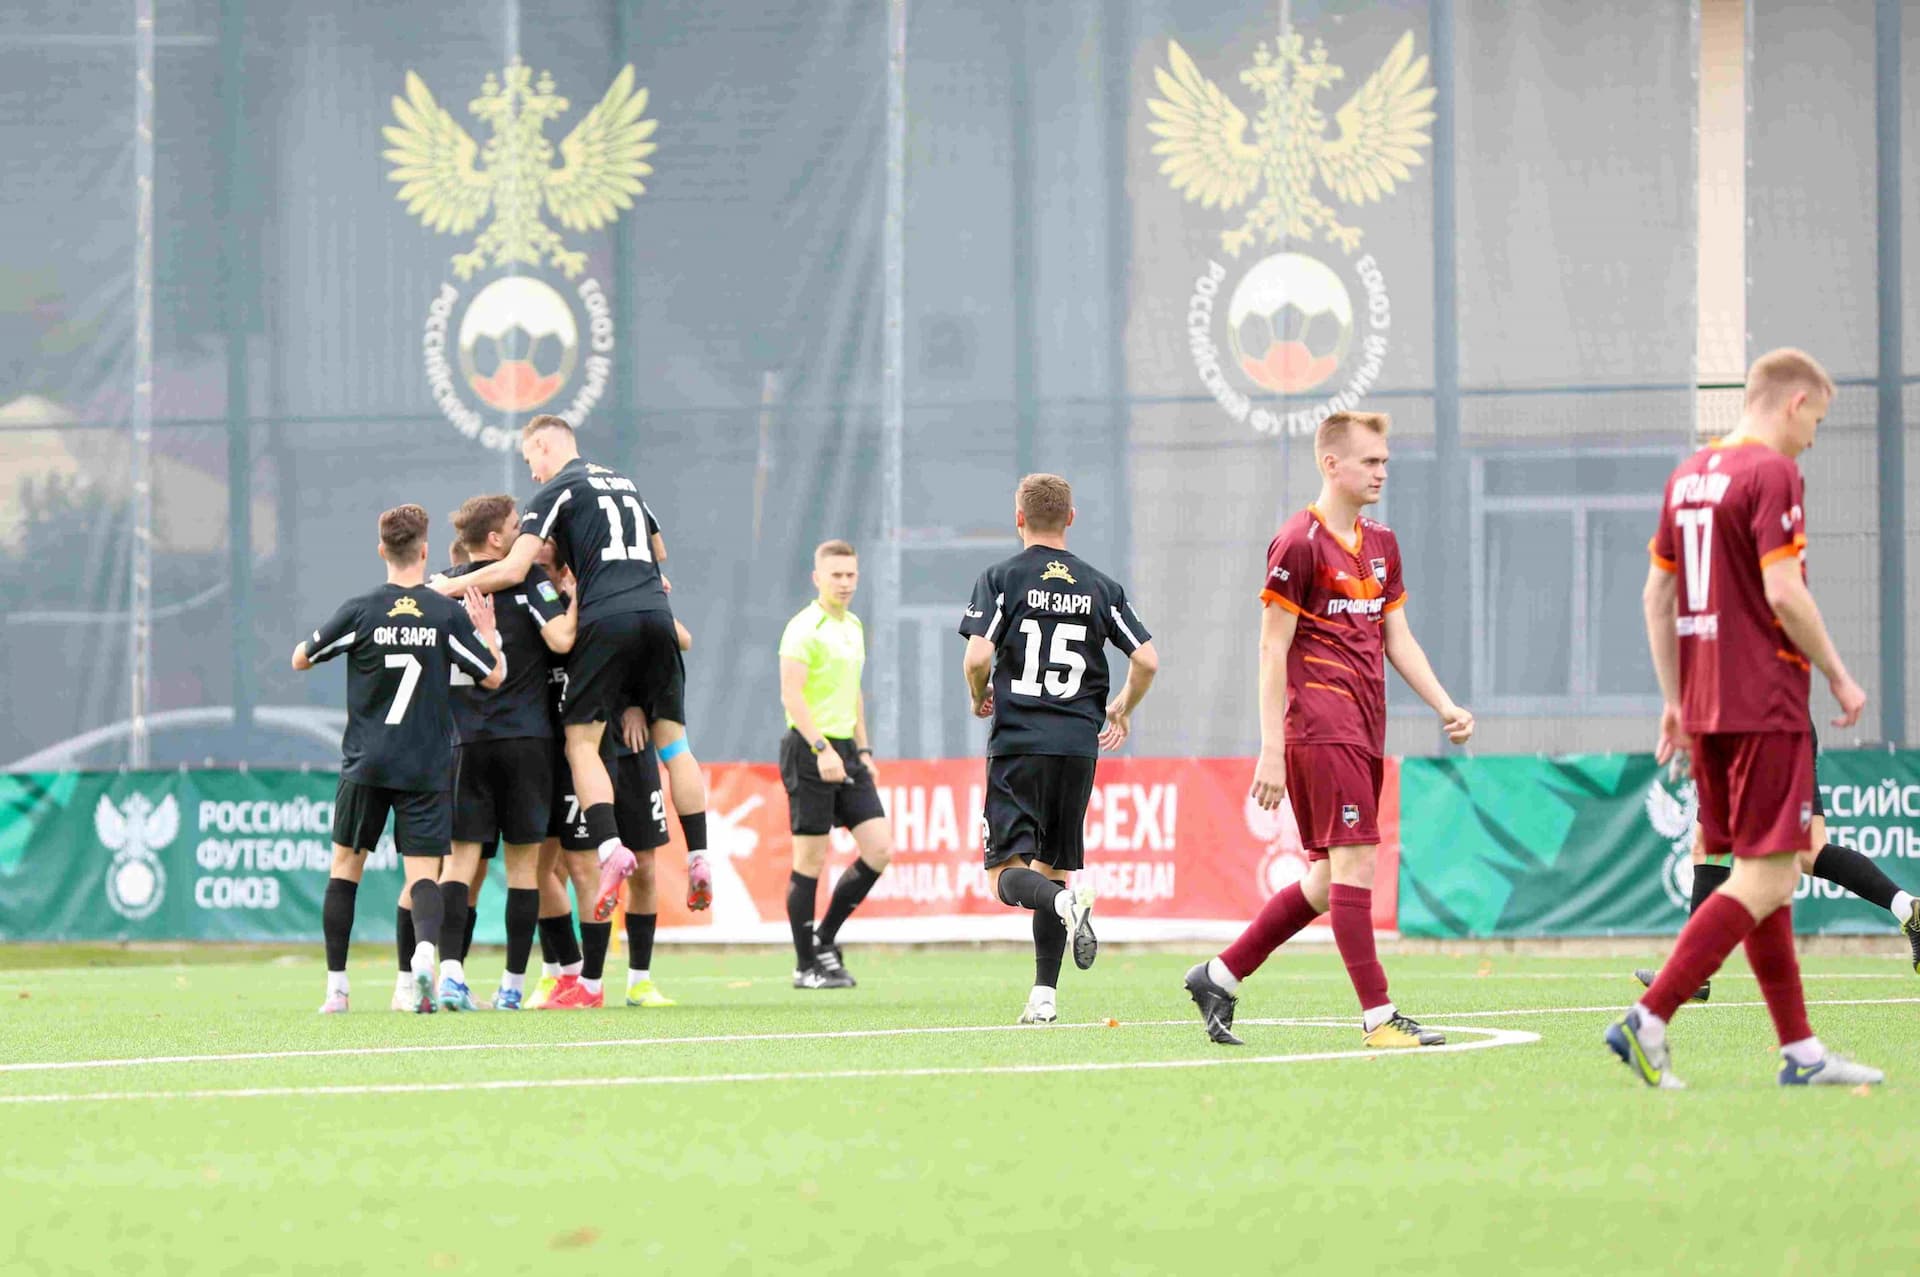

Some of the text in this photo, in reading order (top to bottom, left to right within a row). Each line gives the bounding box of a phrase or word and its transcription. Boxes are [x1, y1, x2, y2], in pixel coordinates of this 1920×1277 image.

[1188, 259, 1251, 422] РОССИЙСКИЙ
[1355, 254, 1391, 330] СОЮЗ
[597, 495, 653, 563] 11
[1027, 589, 1092, 615] ФК ЗАРЯ
[373, 626, 437, 648] ФК ЗАРЯ
[1010, 618, 1087, 699] 15
[383, 653, 423, 725] 7
[198, 794, 336, 832] РОССИЙС
[1083, 783, 1178, 852] СЕХ!
[194, 876, 281, 910] СОЮЗ
